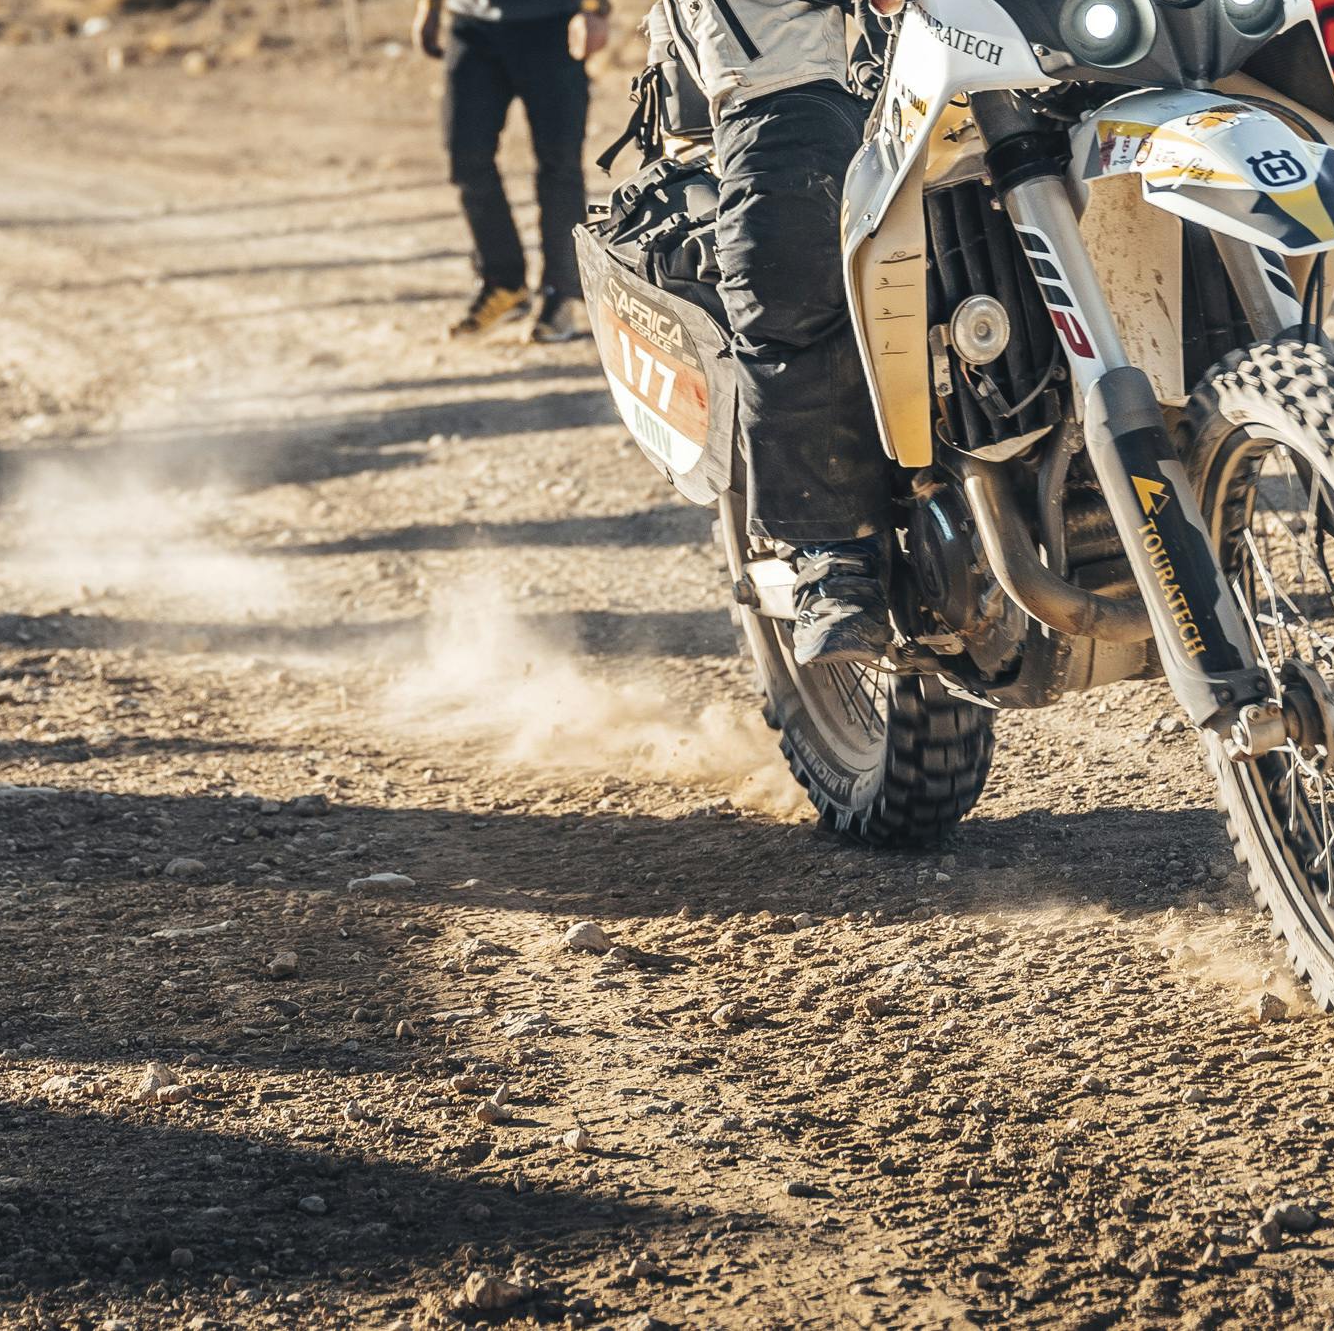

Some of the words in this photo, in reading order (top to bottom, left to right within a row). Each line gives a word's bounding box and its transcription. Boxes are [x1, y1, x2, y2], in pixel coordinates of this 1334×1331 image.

[617, 291, 683, 348] AFRICA
[618, 329, 677, 413] 177
[1137, 518, 1207, 659] TOURATECH
